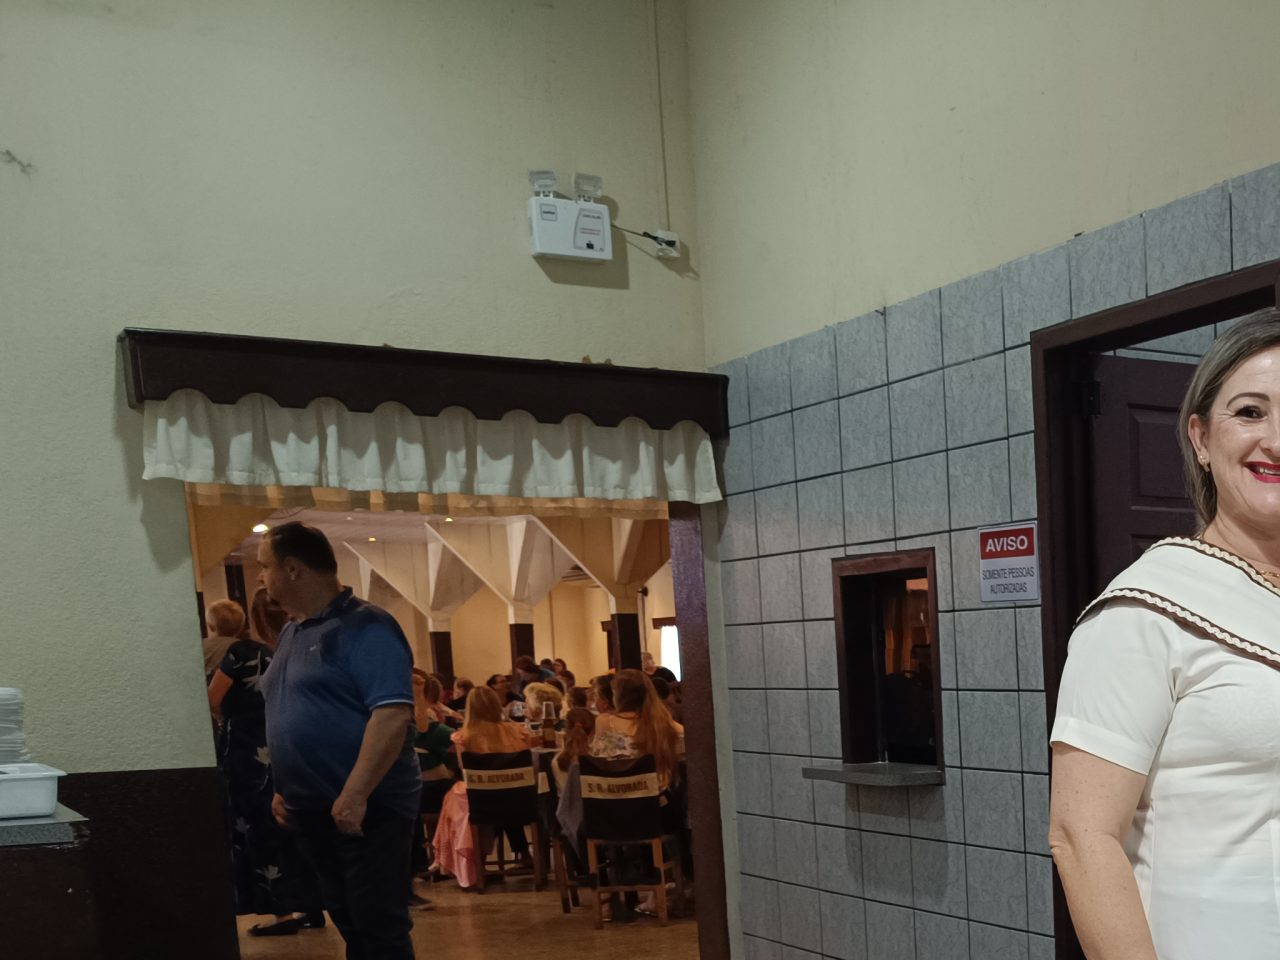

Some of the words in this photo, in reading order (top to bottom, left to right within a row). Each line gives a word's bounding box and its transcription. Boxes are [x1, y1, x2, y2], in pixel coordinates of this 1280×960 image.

[986, 535, 1028, 552] AVISO
[982, 568, 1007, 580] SOMENTE
[1008, 566, 1034, 579] PESSOAS
[990, 582, 1027, 594] AUTORIZADAS
[607, 780, 649, 793] ALVORADA
